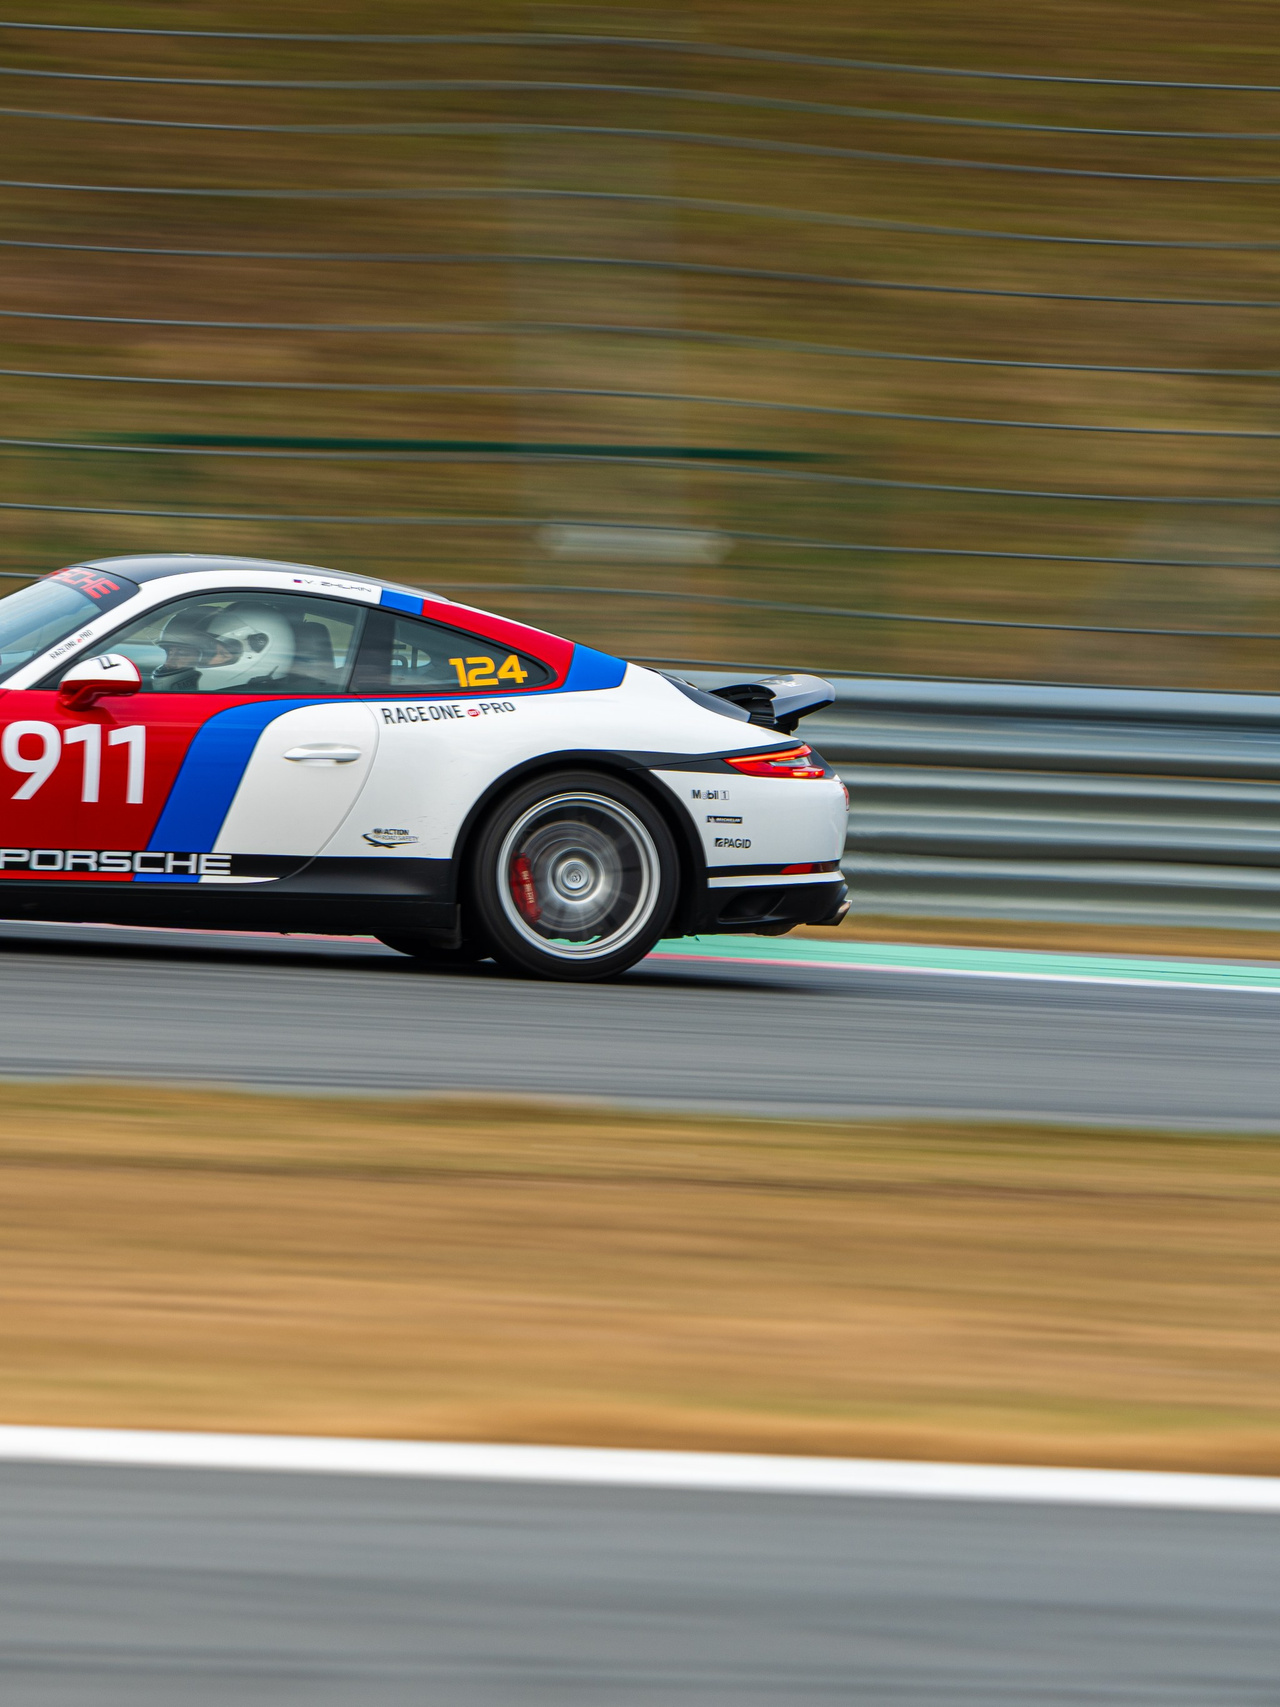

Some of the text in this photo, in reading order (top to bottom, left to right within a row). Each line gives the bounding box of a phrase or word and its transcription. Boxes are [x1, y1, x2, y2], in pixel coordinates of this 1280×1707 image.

[449, 655, 528, 687] 124
[479, 701, 517, 715] PRO
[1, 720, 146, 804] 911
[692, 789, 719, 800] Mobil
[384, 828, 410, 836] ACTION
[723, 838, 752, 849] PAGID
